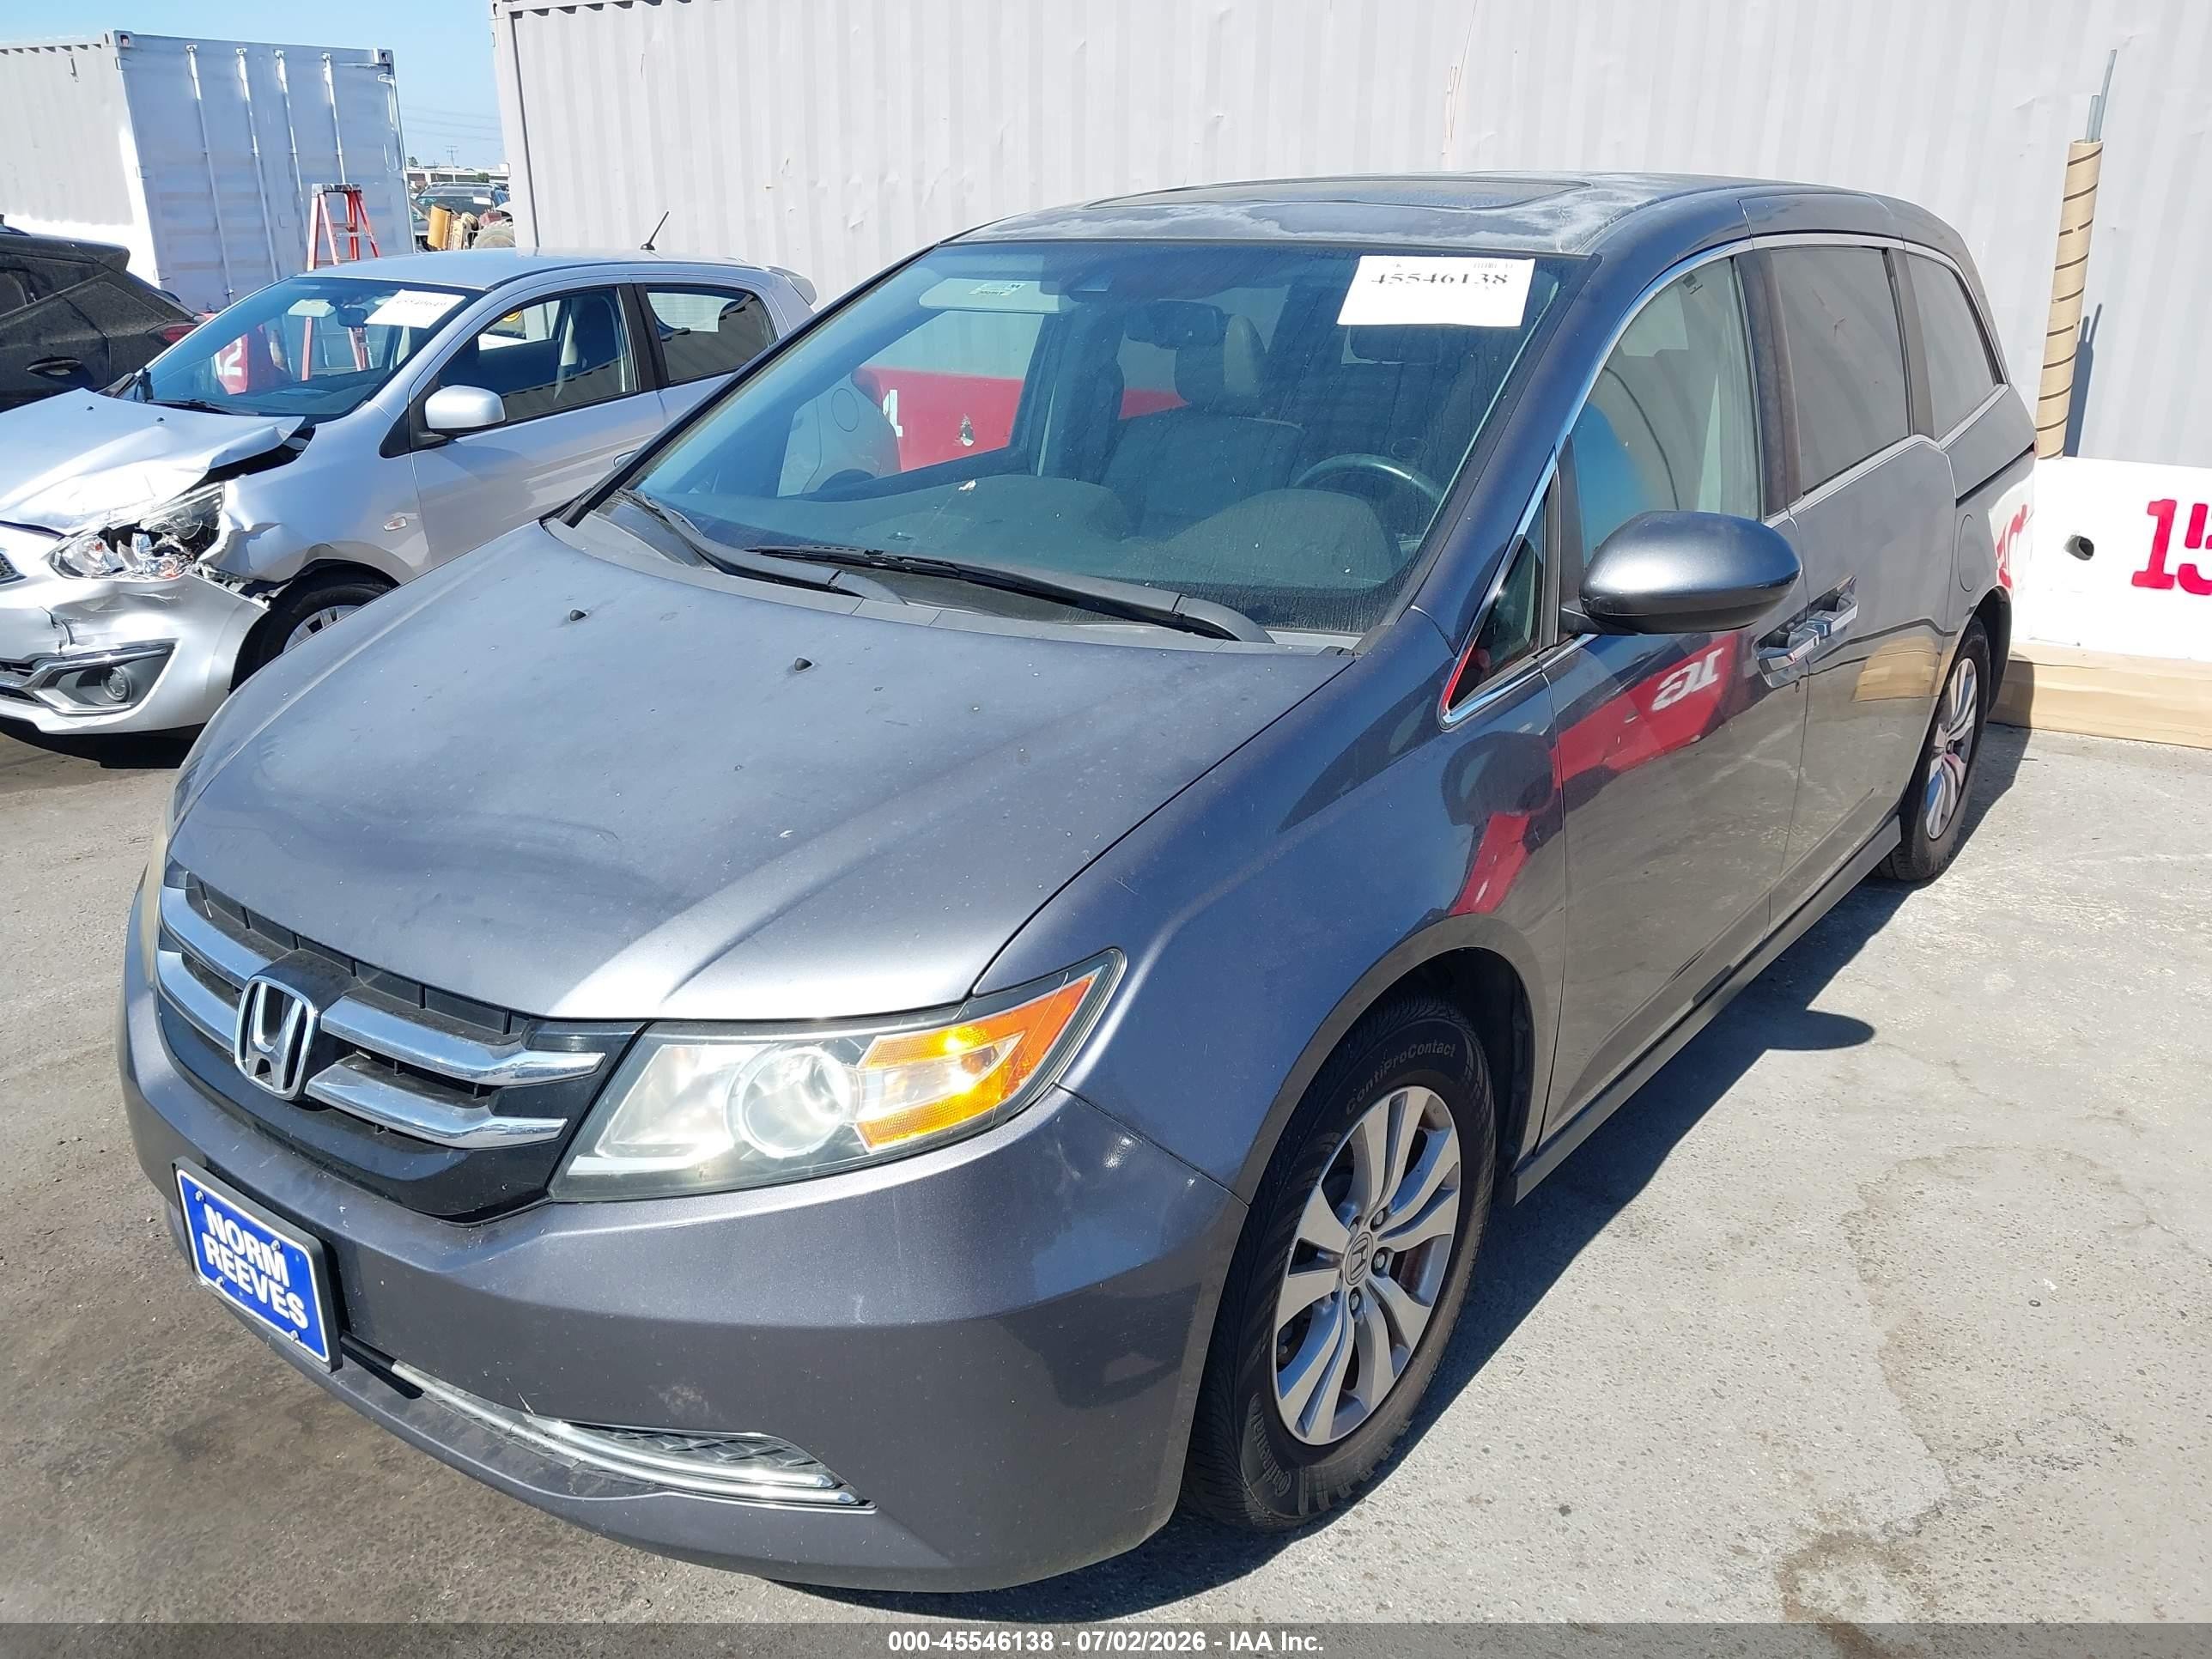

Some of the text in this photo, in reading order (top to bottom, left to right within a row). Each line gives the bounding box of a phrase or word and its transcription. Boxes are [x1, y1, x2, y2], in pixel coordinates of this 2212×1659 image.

[1371, 272, 1509, 285] 45546138
[1346, 1039, 1456, 1115] ContiProContact
[201, 1232, 309, 1329] REEVES
[204, 1202, 290, 1288] NORM
